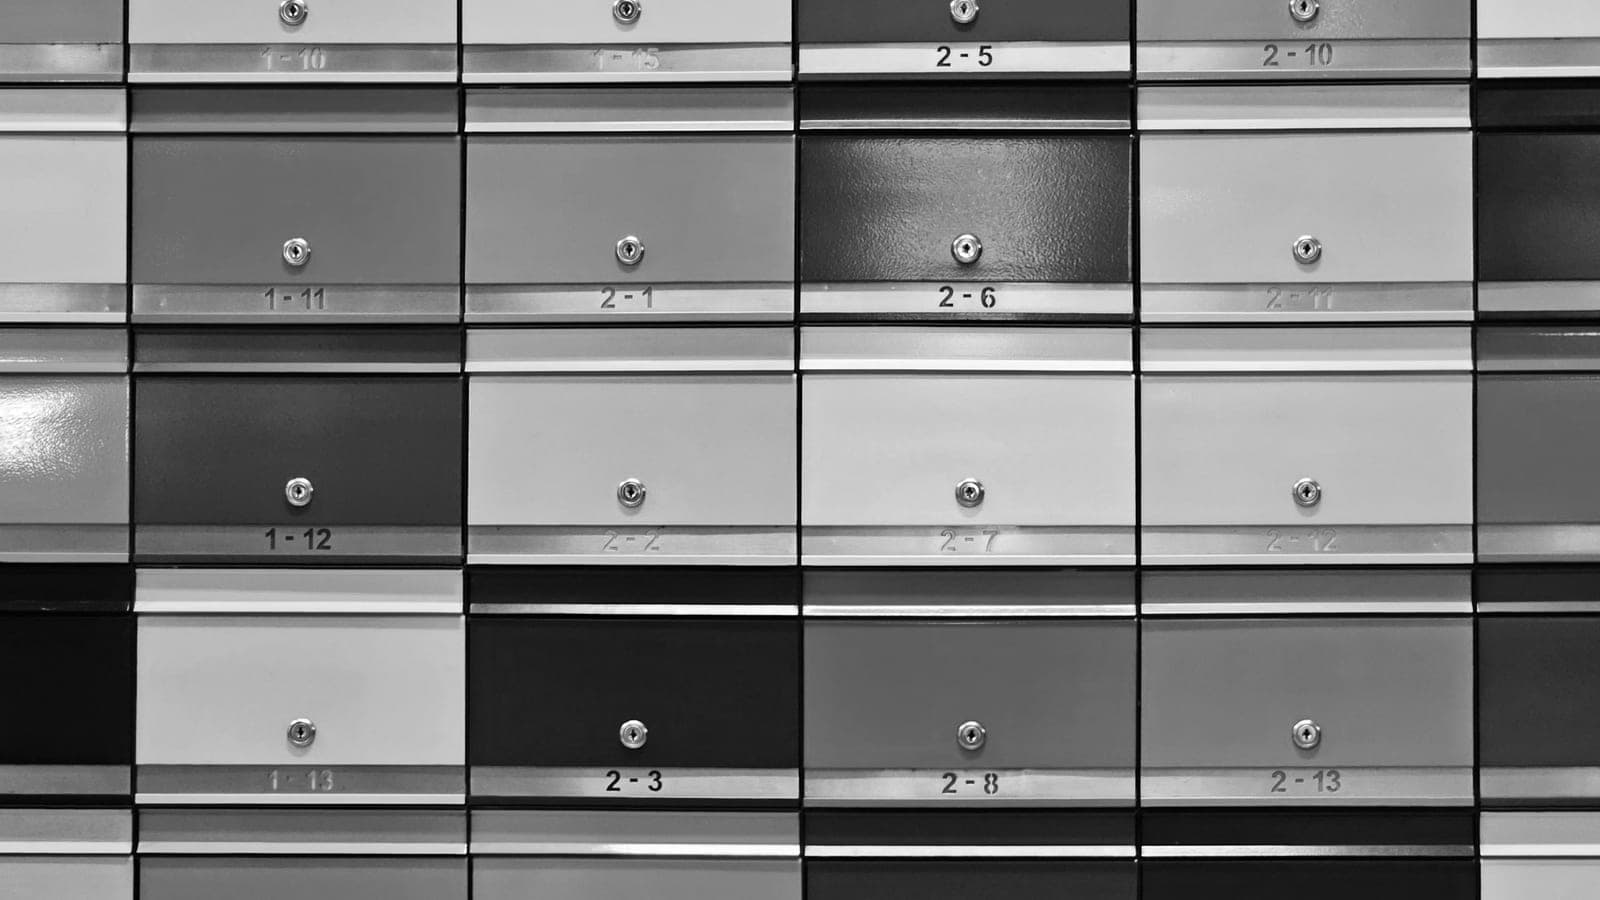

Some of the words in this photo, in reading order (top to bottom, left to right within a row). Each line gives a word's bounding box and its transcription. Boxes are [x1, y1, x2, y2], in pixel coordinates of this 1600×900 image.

[261, 47, 272, 69] 1
[298, 47, 326, 69] 10
[936, 45, 951, 67] 2
[978, 45, 993, 67] 5
[1263, 44, 1278, 66] 2
[1304, 43, 1333, 66] 10
[265, 287, 275, 310] 1
[301, 287, 324, 310] 11
[600, 286, 616, 308] 2
[642, 286, 652, 308] 1
[939, 285, 954, 307] 2
[981, 285, 996, 308] 6
[1266, 286, 1282, 309] 2
[1307, 286, 1333, 309] 11
[265, 527, 276, 550] 1
[304, 527, 331, 550] 12
[603, 529, 618, 551] 2
[644, 529, 660, 551] 2
[940, 528, 956, 551] 2
[982, 529, 999, 552] 7
[1267, 528, 1282, 551] 2
[1307, 528, 1337, 551] 12
[267, 769, 278, 791] 1
[307, 769, 333, 791] 13
[606, 770, 621, 791] 2
[648, 770, 662, 791] 3
[942, 772, 957, 794] 2
[984, 772, 998, 794] 8
[1271, 770, 1286, 792] 2
[1312, 770, 1341, 793] 13
